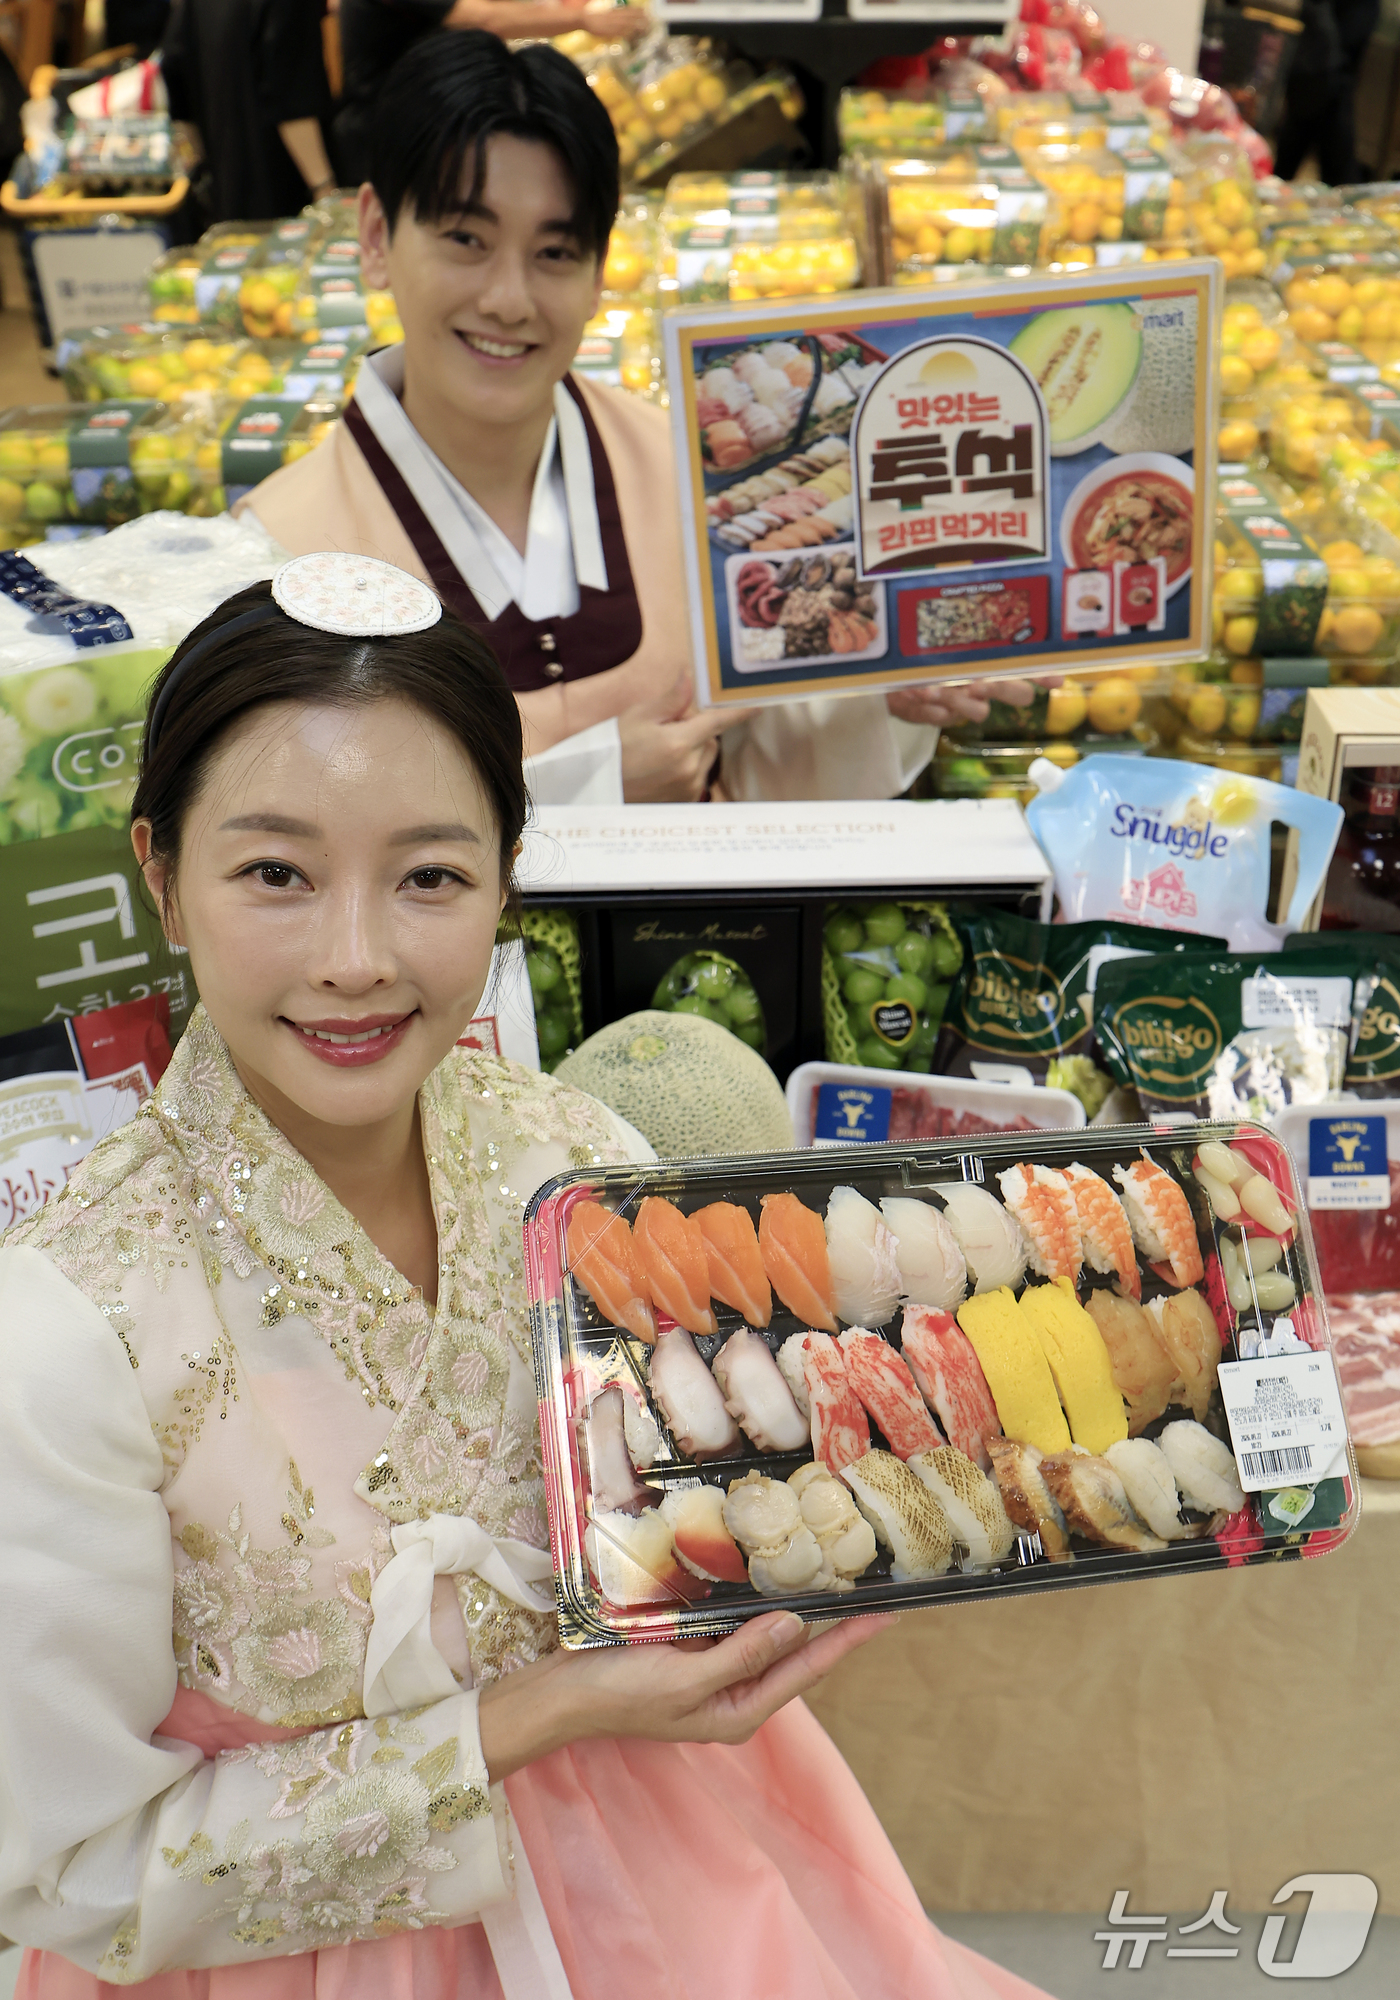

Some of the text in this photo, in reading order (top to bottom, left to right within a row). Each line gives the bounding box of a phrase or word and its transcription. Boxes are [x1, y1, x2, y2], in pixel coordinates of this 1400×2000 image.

[896, 392, 1000, 430] 맛있는
[869, 423, 1035, 512] 추석
[878, 511, 1028, 552] 간편 먹거리
[1375, 792, 1394, 809] 12
[599, 825, 737, 839] CHOICEST
[744, 821, 897, 836] SELECTION
[1110, 803, 1229, 861] Snuggle
[1122, 1015, 1214, 1059] bibigo
[0, 1094, 60, 1119] EACOCK
